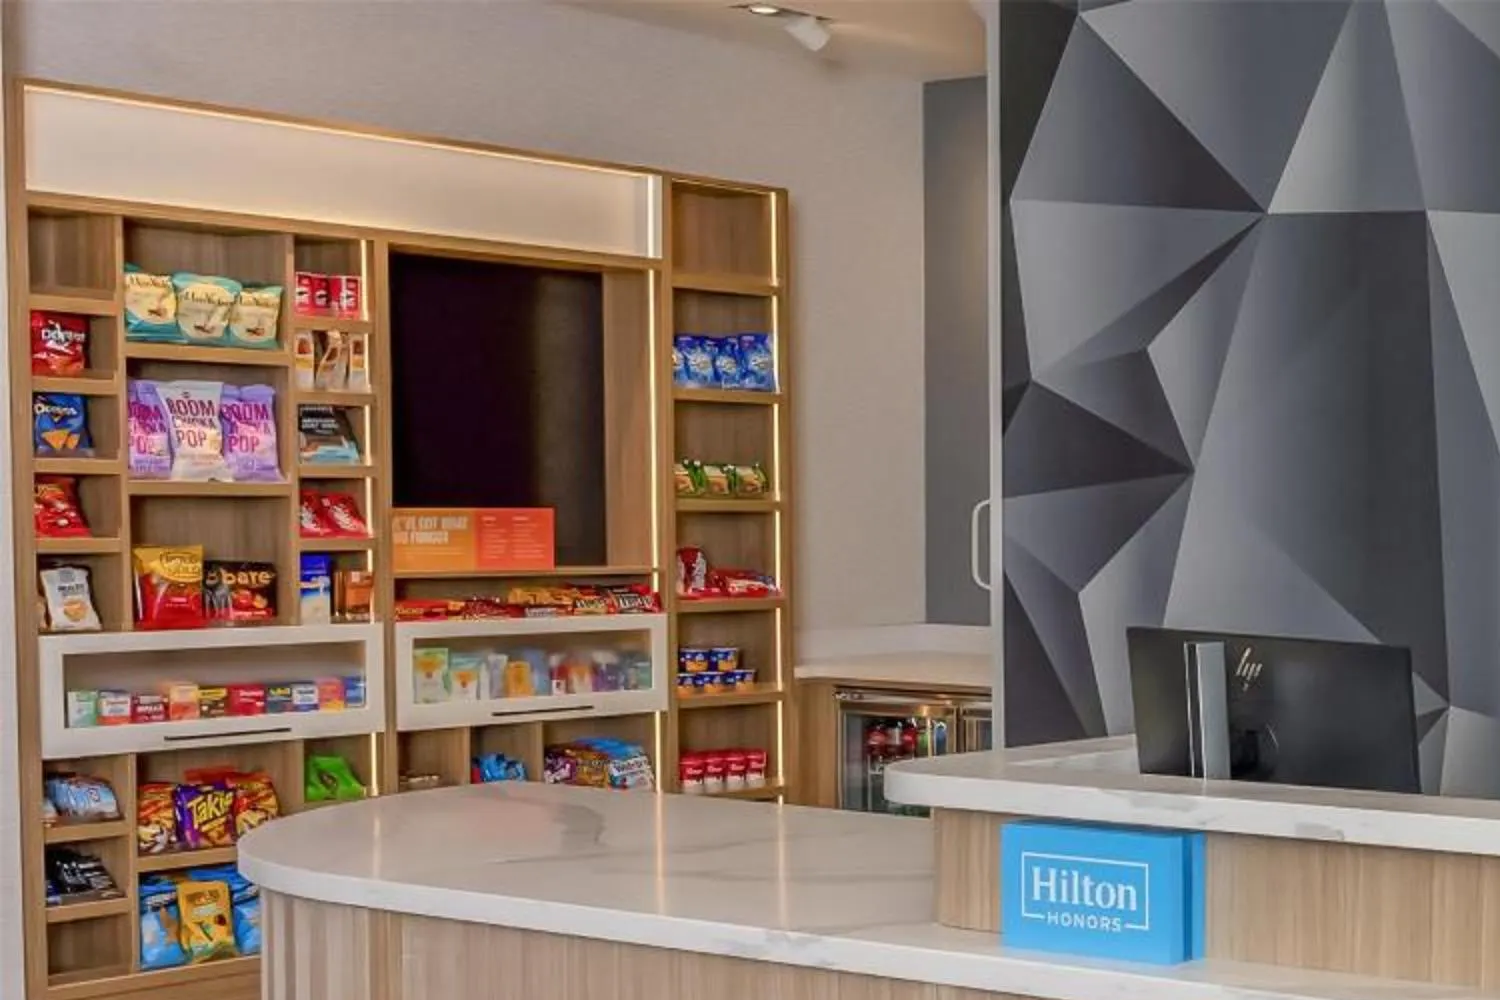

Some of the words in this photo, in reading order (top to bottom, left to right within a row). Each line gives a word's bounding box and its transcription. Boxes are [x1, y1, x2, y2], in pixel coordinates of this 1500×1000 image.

[166, 397, 215, 417] BOOM
[176, 429, 208, 449] POP
[228, 435, 259, 453] POP
[221, 567, 271, 587] bare
[1032, 866, 1137, 911] Hilton
[1046, 910, 1122, 933] HONORS
